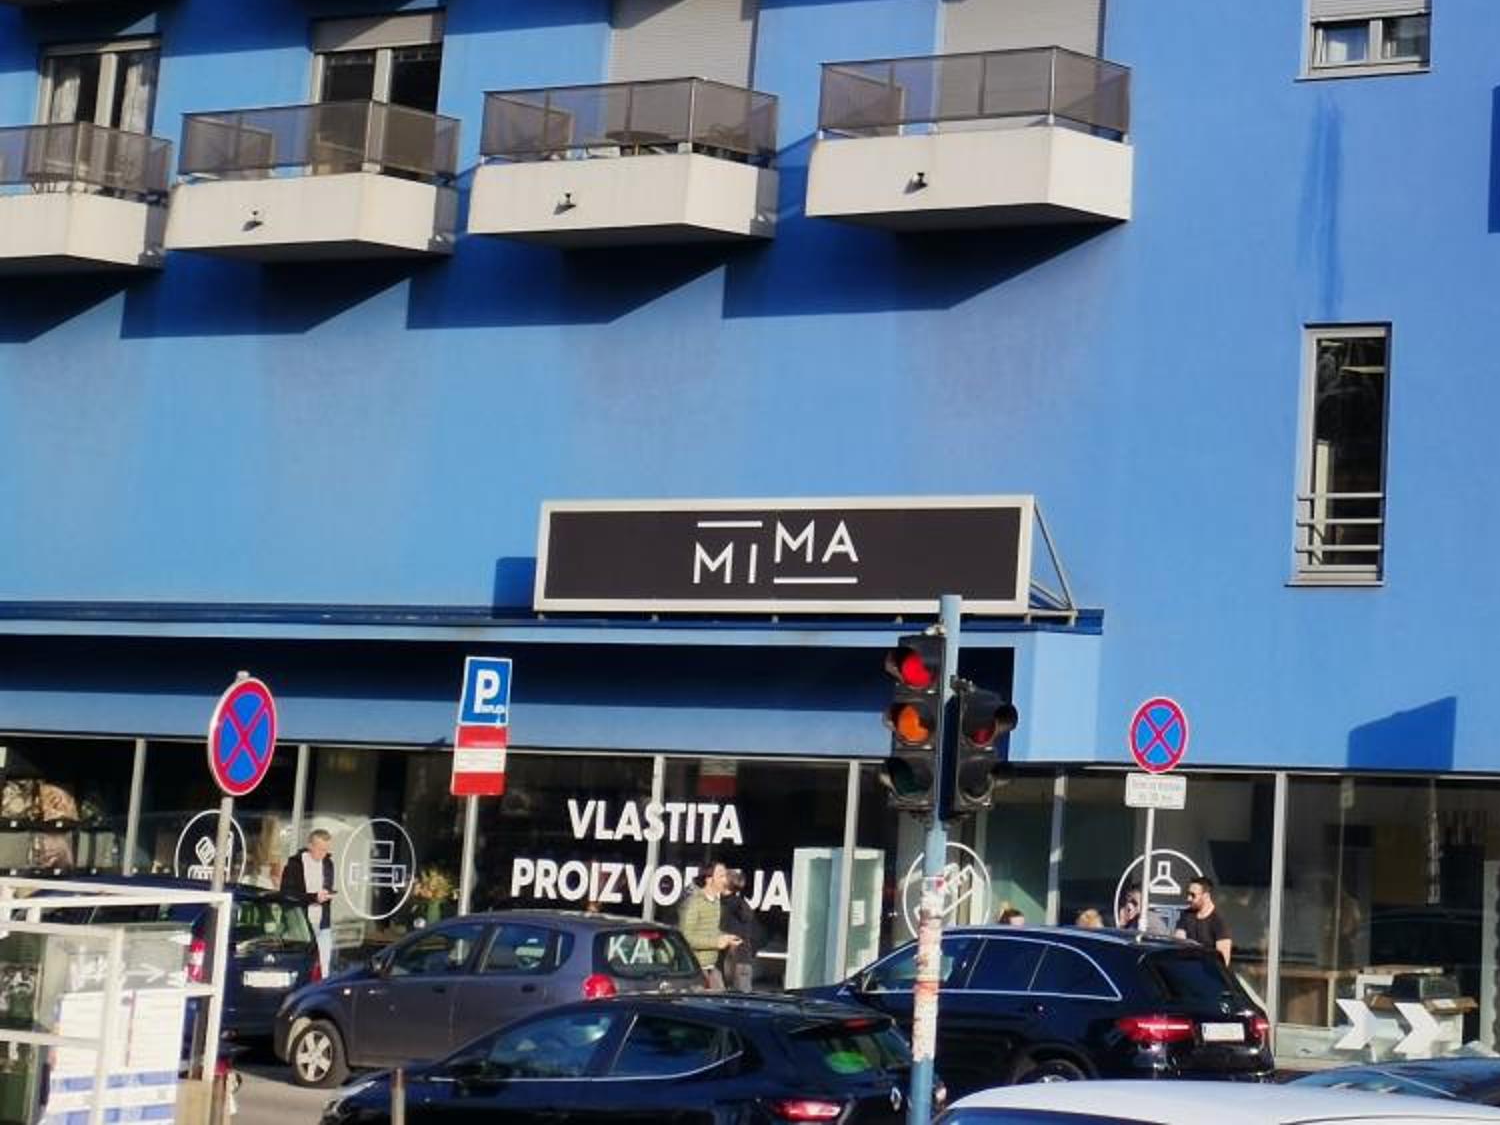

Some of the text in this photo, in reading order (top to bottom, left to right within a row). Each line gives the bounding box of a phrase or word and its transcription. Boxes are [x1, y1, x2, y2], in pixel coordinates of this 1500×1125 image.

[692, 519, 860, 585] MIMA
[473, 668, 500, 714] P
[567, 798, 743, 845] VLASTITA
[510, 858, 793, 912] PROIZVOJA
